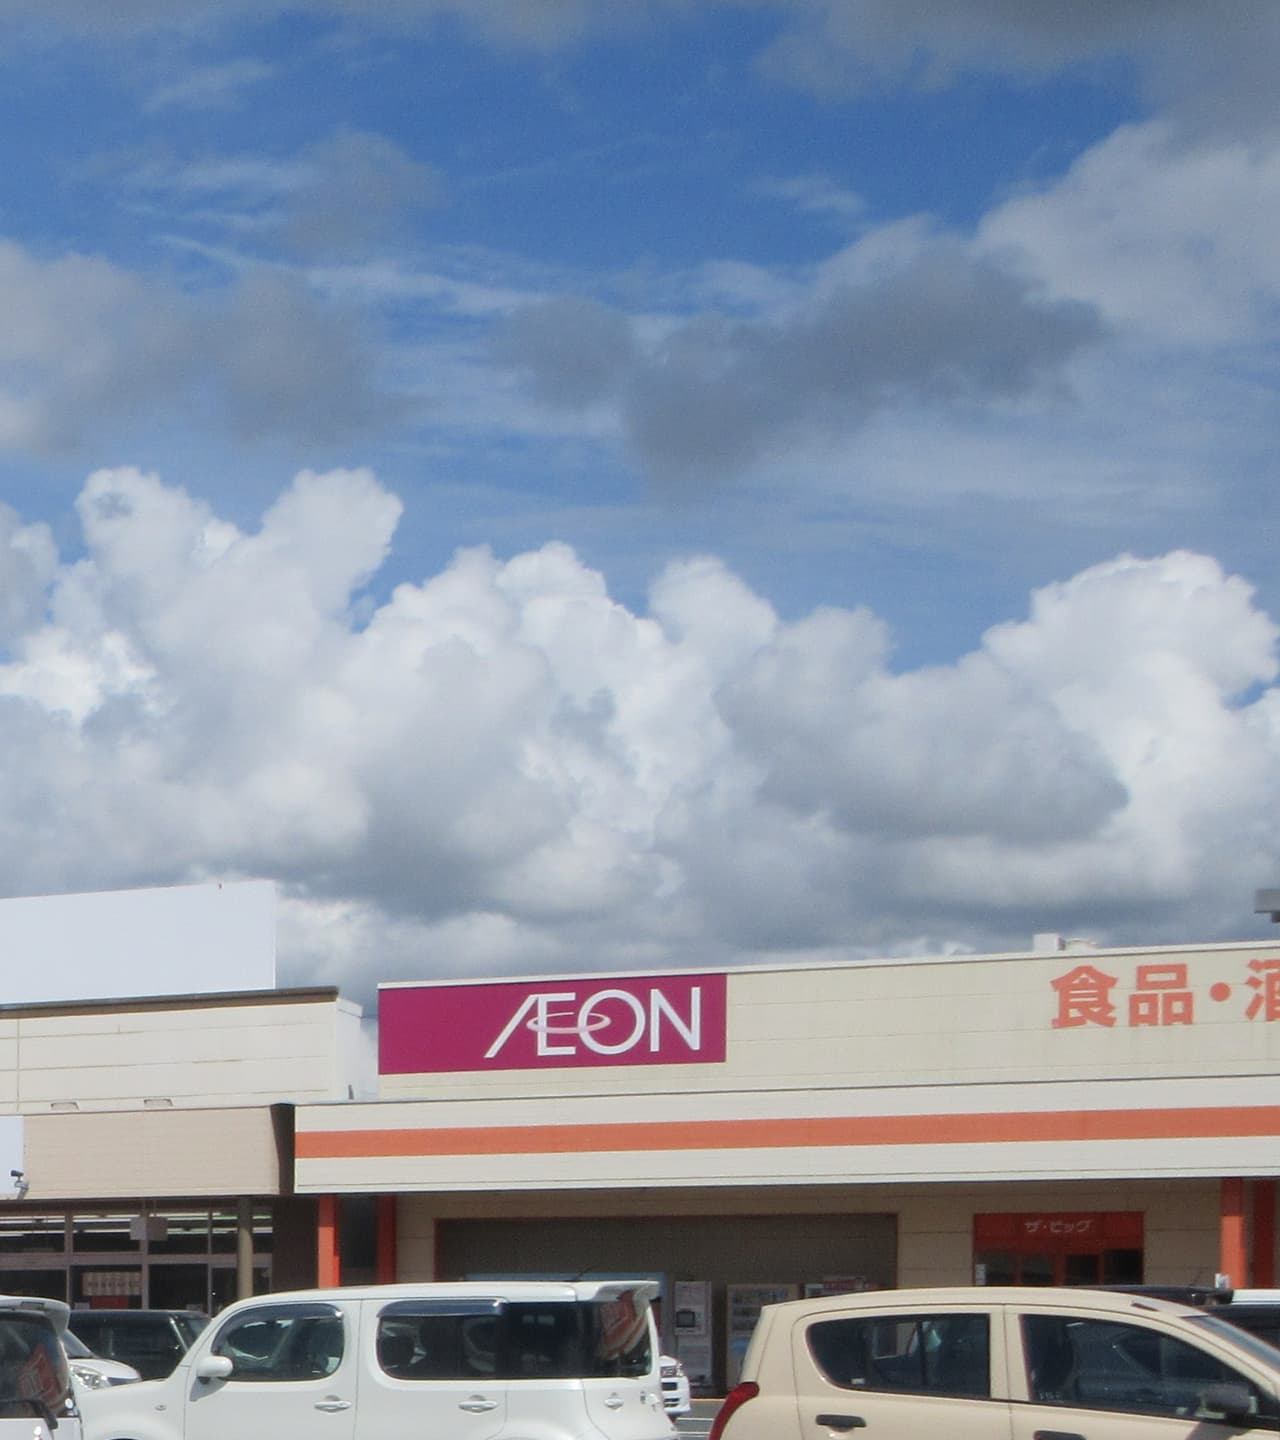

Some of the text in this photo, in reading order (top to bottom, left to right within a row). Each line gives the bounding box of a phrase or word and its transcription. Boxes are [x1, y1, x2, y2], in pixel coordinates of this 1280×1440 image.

[1024, 1219, 1094, 1233] ザ・ビッグ
